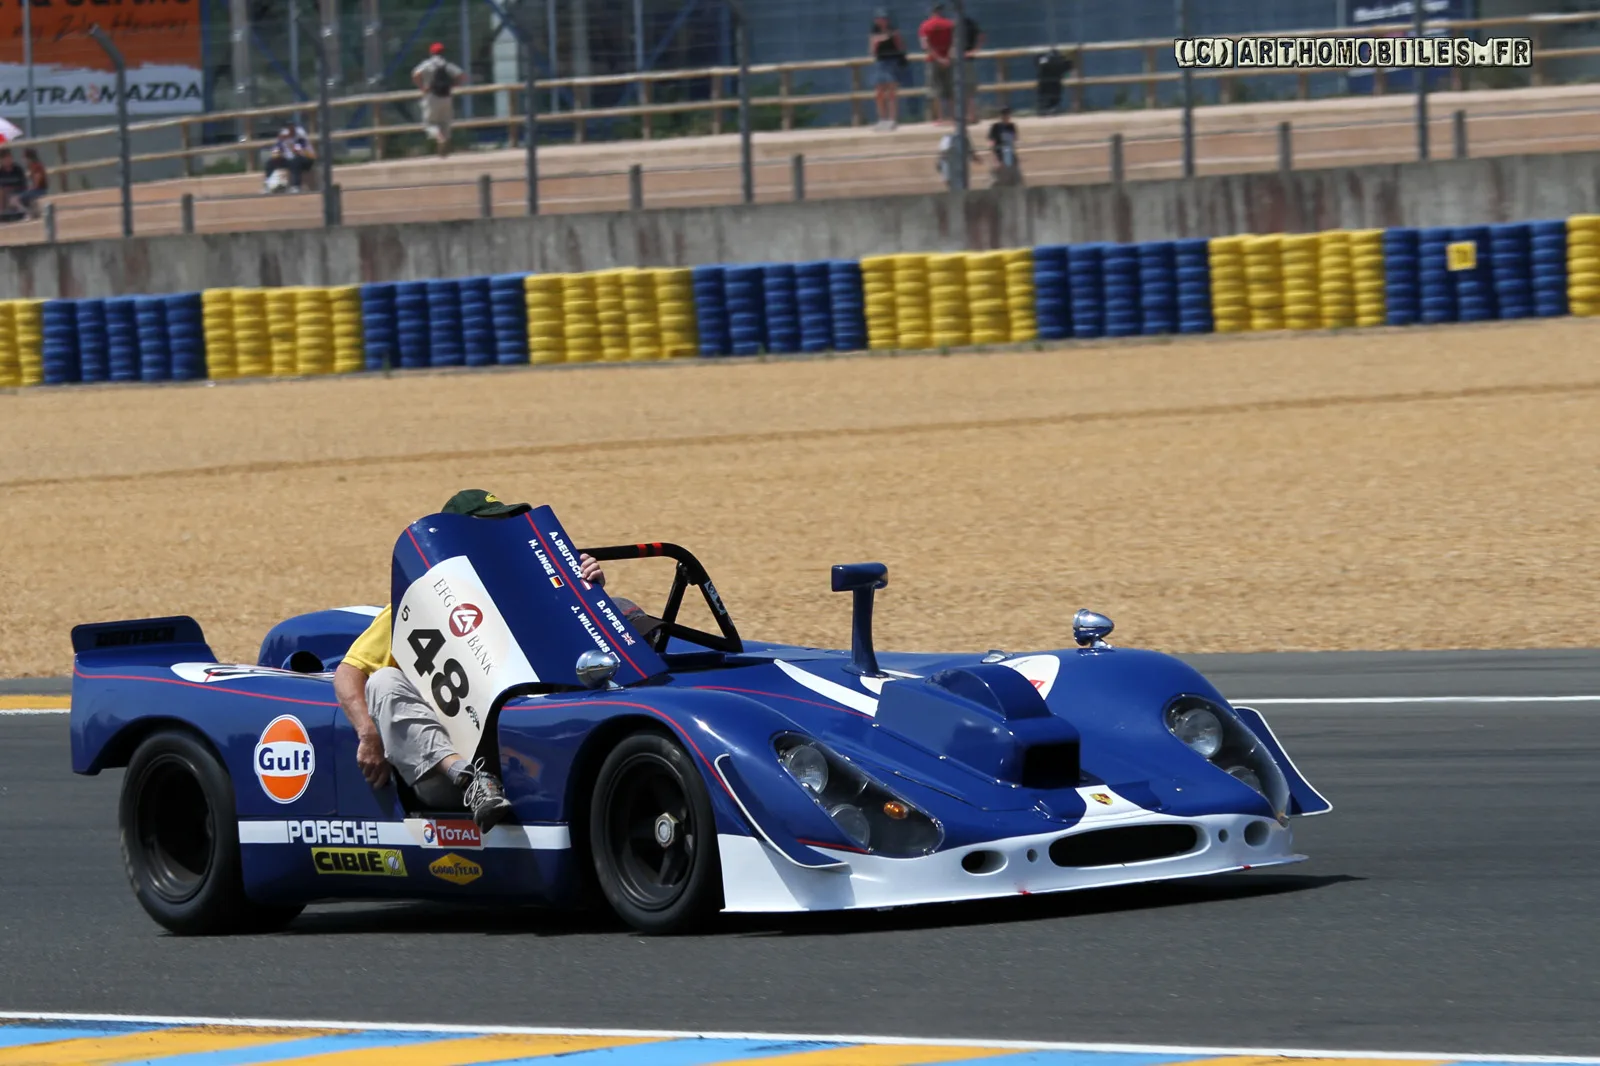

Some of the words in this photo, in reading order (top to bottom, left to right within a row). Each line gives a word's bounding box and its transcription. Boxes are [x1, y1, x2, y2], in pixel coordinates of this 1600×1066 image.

[534, 549, 556, 575] LINGE
[401, 604, 411, 621] 5
[433, 578, 456, 608] EFG
[467, 634, 494, 675] BANK
[577, 612, 611, 653] WILLIAMS
[407, 629, 469, 717] 48
[258, 747, 310, 771] Gulf
[287, 820, 379, 844] PORSCHE
[437, 825, 479, 840] TOTAL
